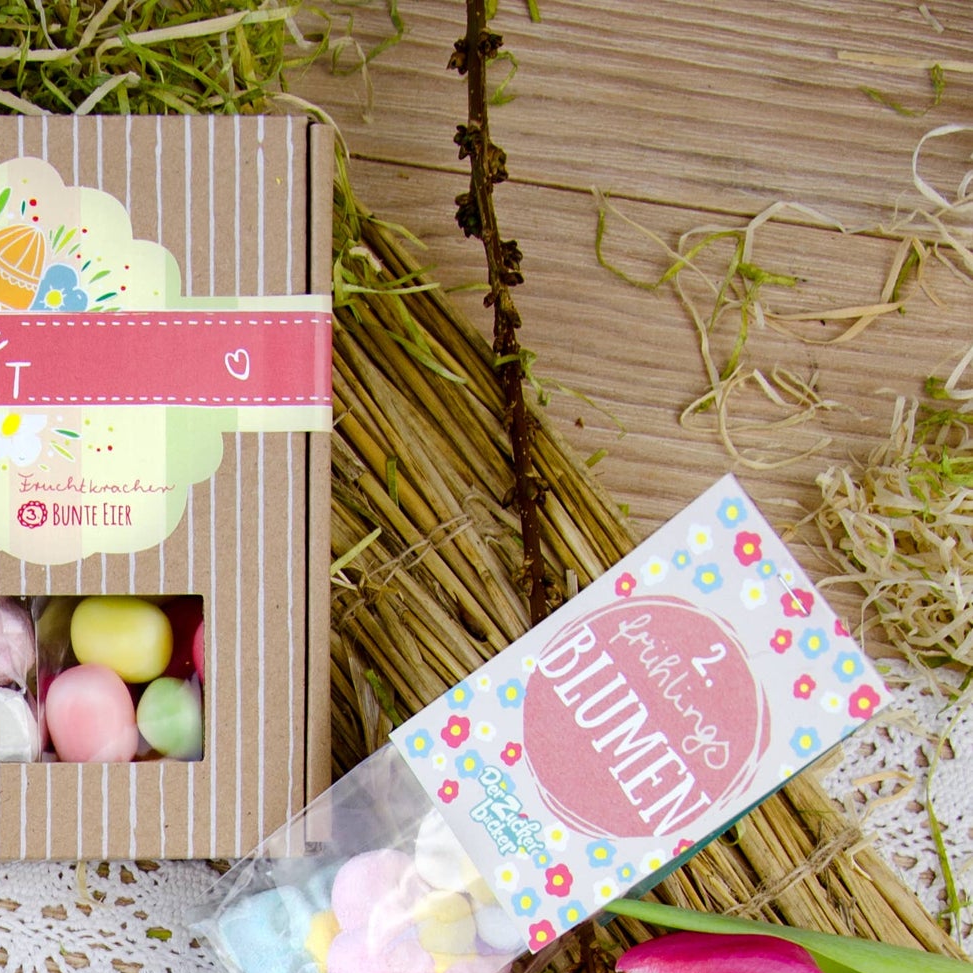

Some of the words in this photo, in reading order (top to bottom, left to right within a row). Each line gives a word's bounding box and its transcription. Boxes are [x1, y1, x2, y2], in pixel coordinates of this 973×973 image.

[52, 502, 97, 526] BUNTE
[103, 503, 132, 526] EIER
[691, 642, 726, 688] 2.
[537, 623, 712, 838] BLUMEN
[479, 765, 509, 803] Der
